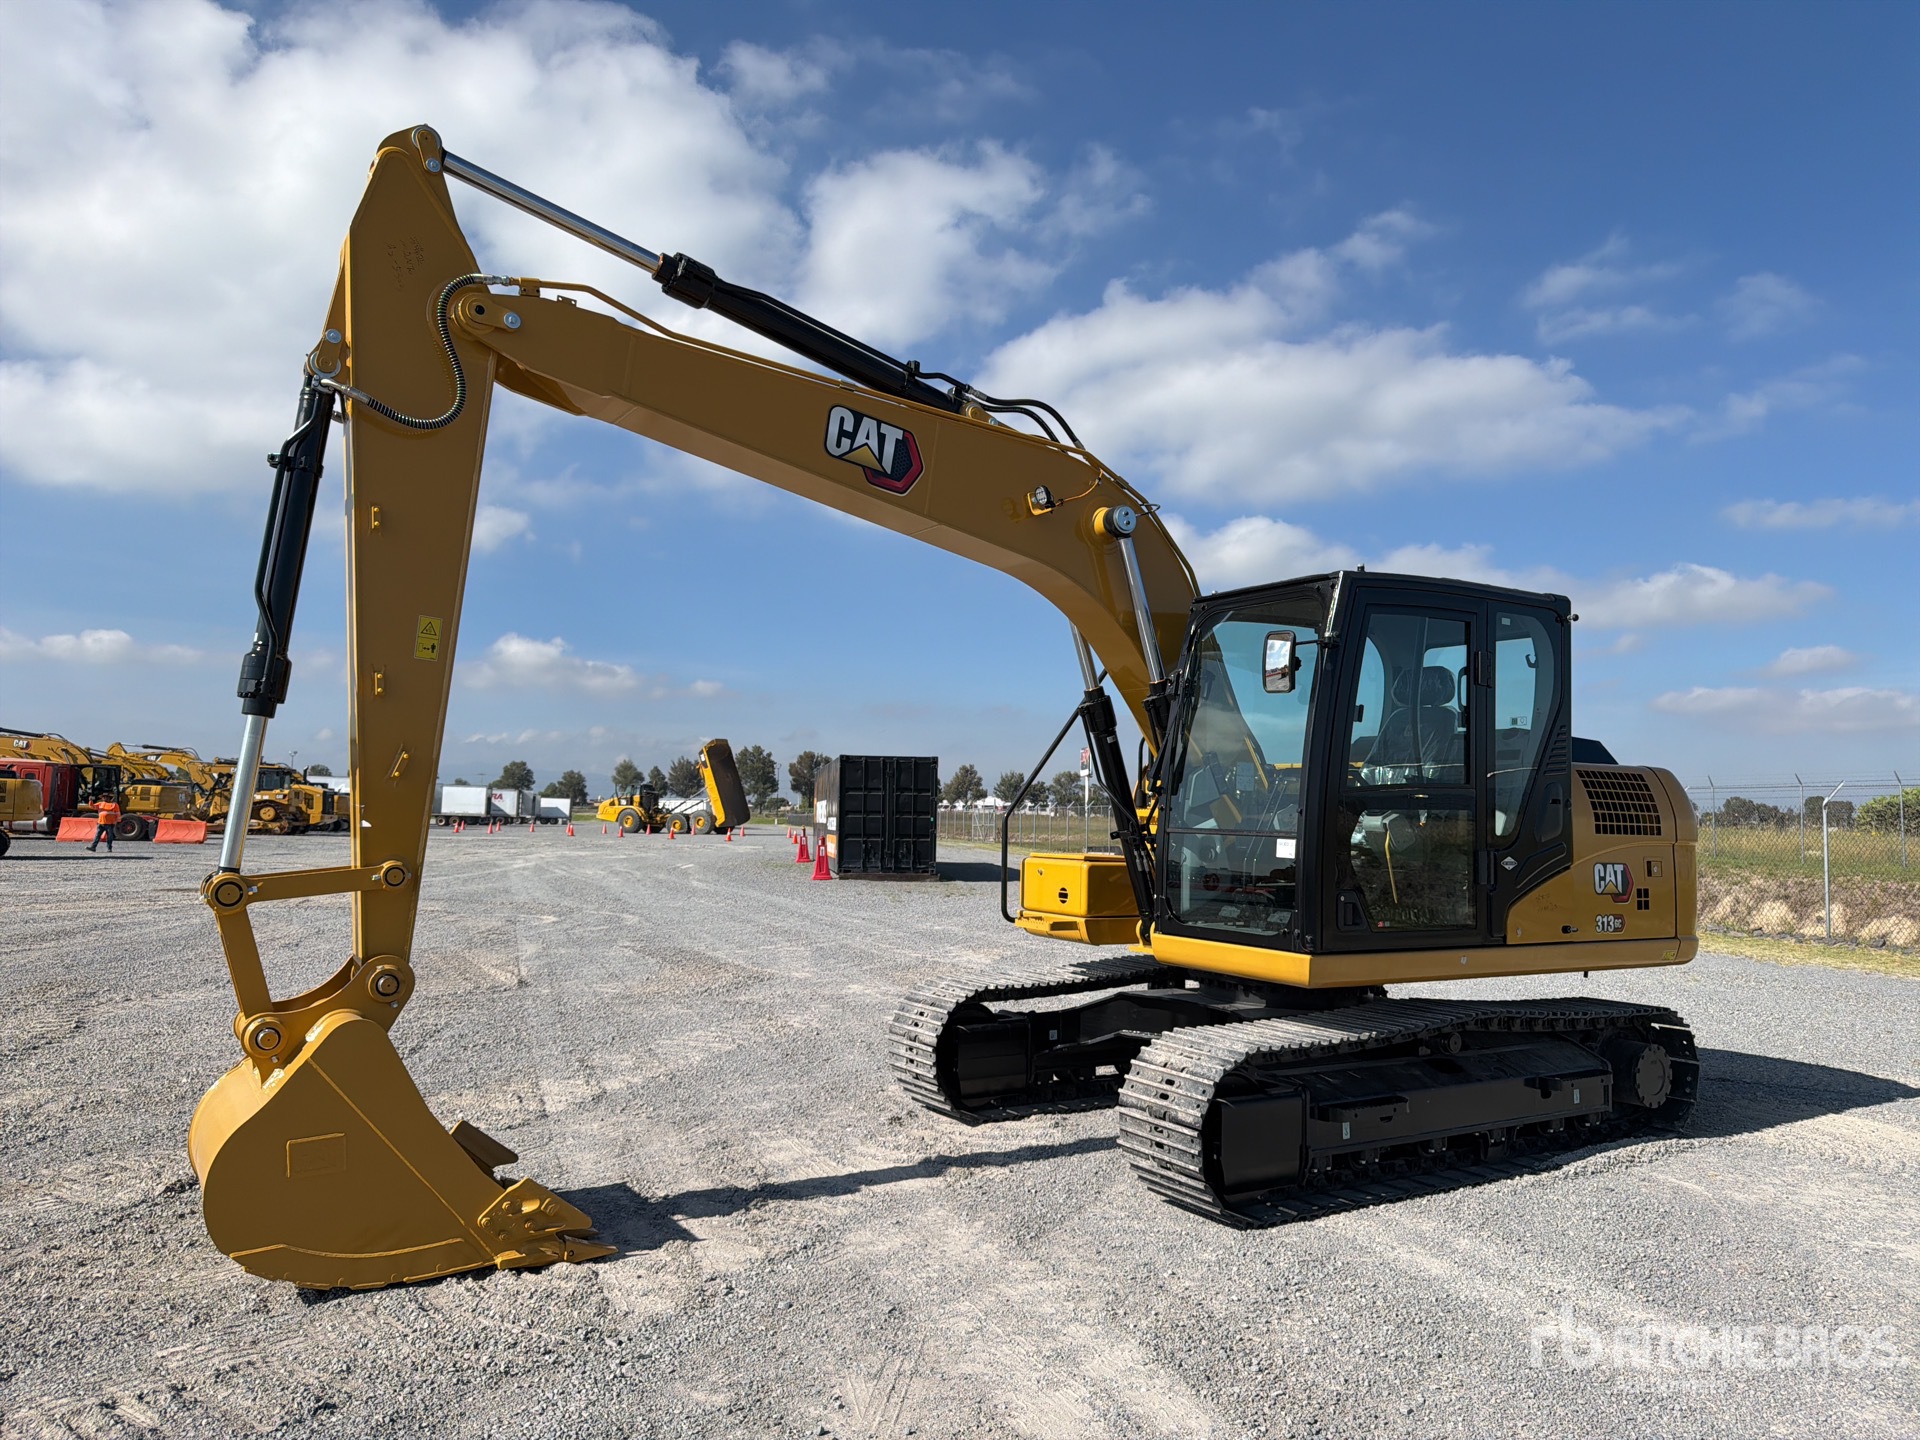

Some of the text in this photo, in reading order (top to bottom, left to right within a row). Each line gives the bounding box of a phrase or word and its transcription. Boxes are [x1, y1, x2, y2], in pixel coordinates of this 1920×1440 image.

[826, 405, 904, 475] CAT
[13, 739, 28, 748] CAT
[1594, 863, 1624, 894] CAT
[1595, 915, 1614, 932] 313
